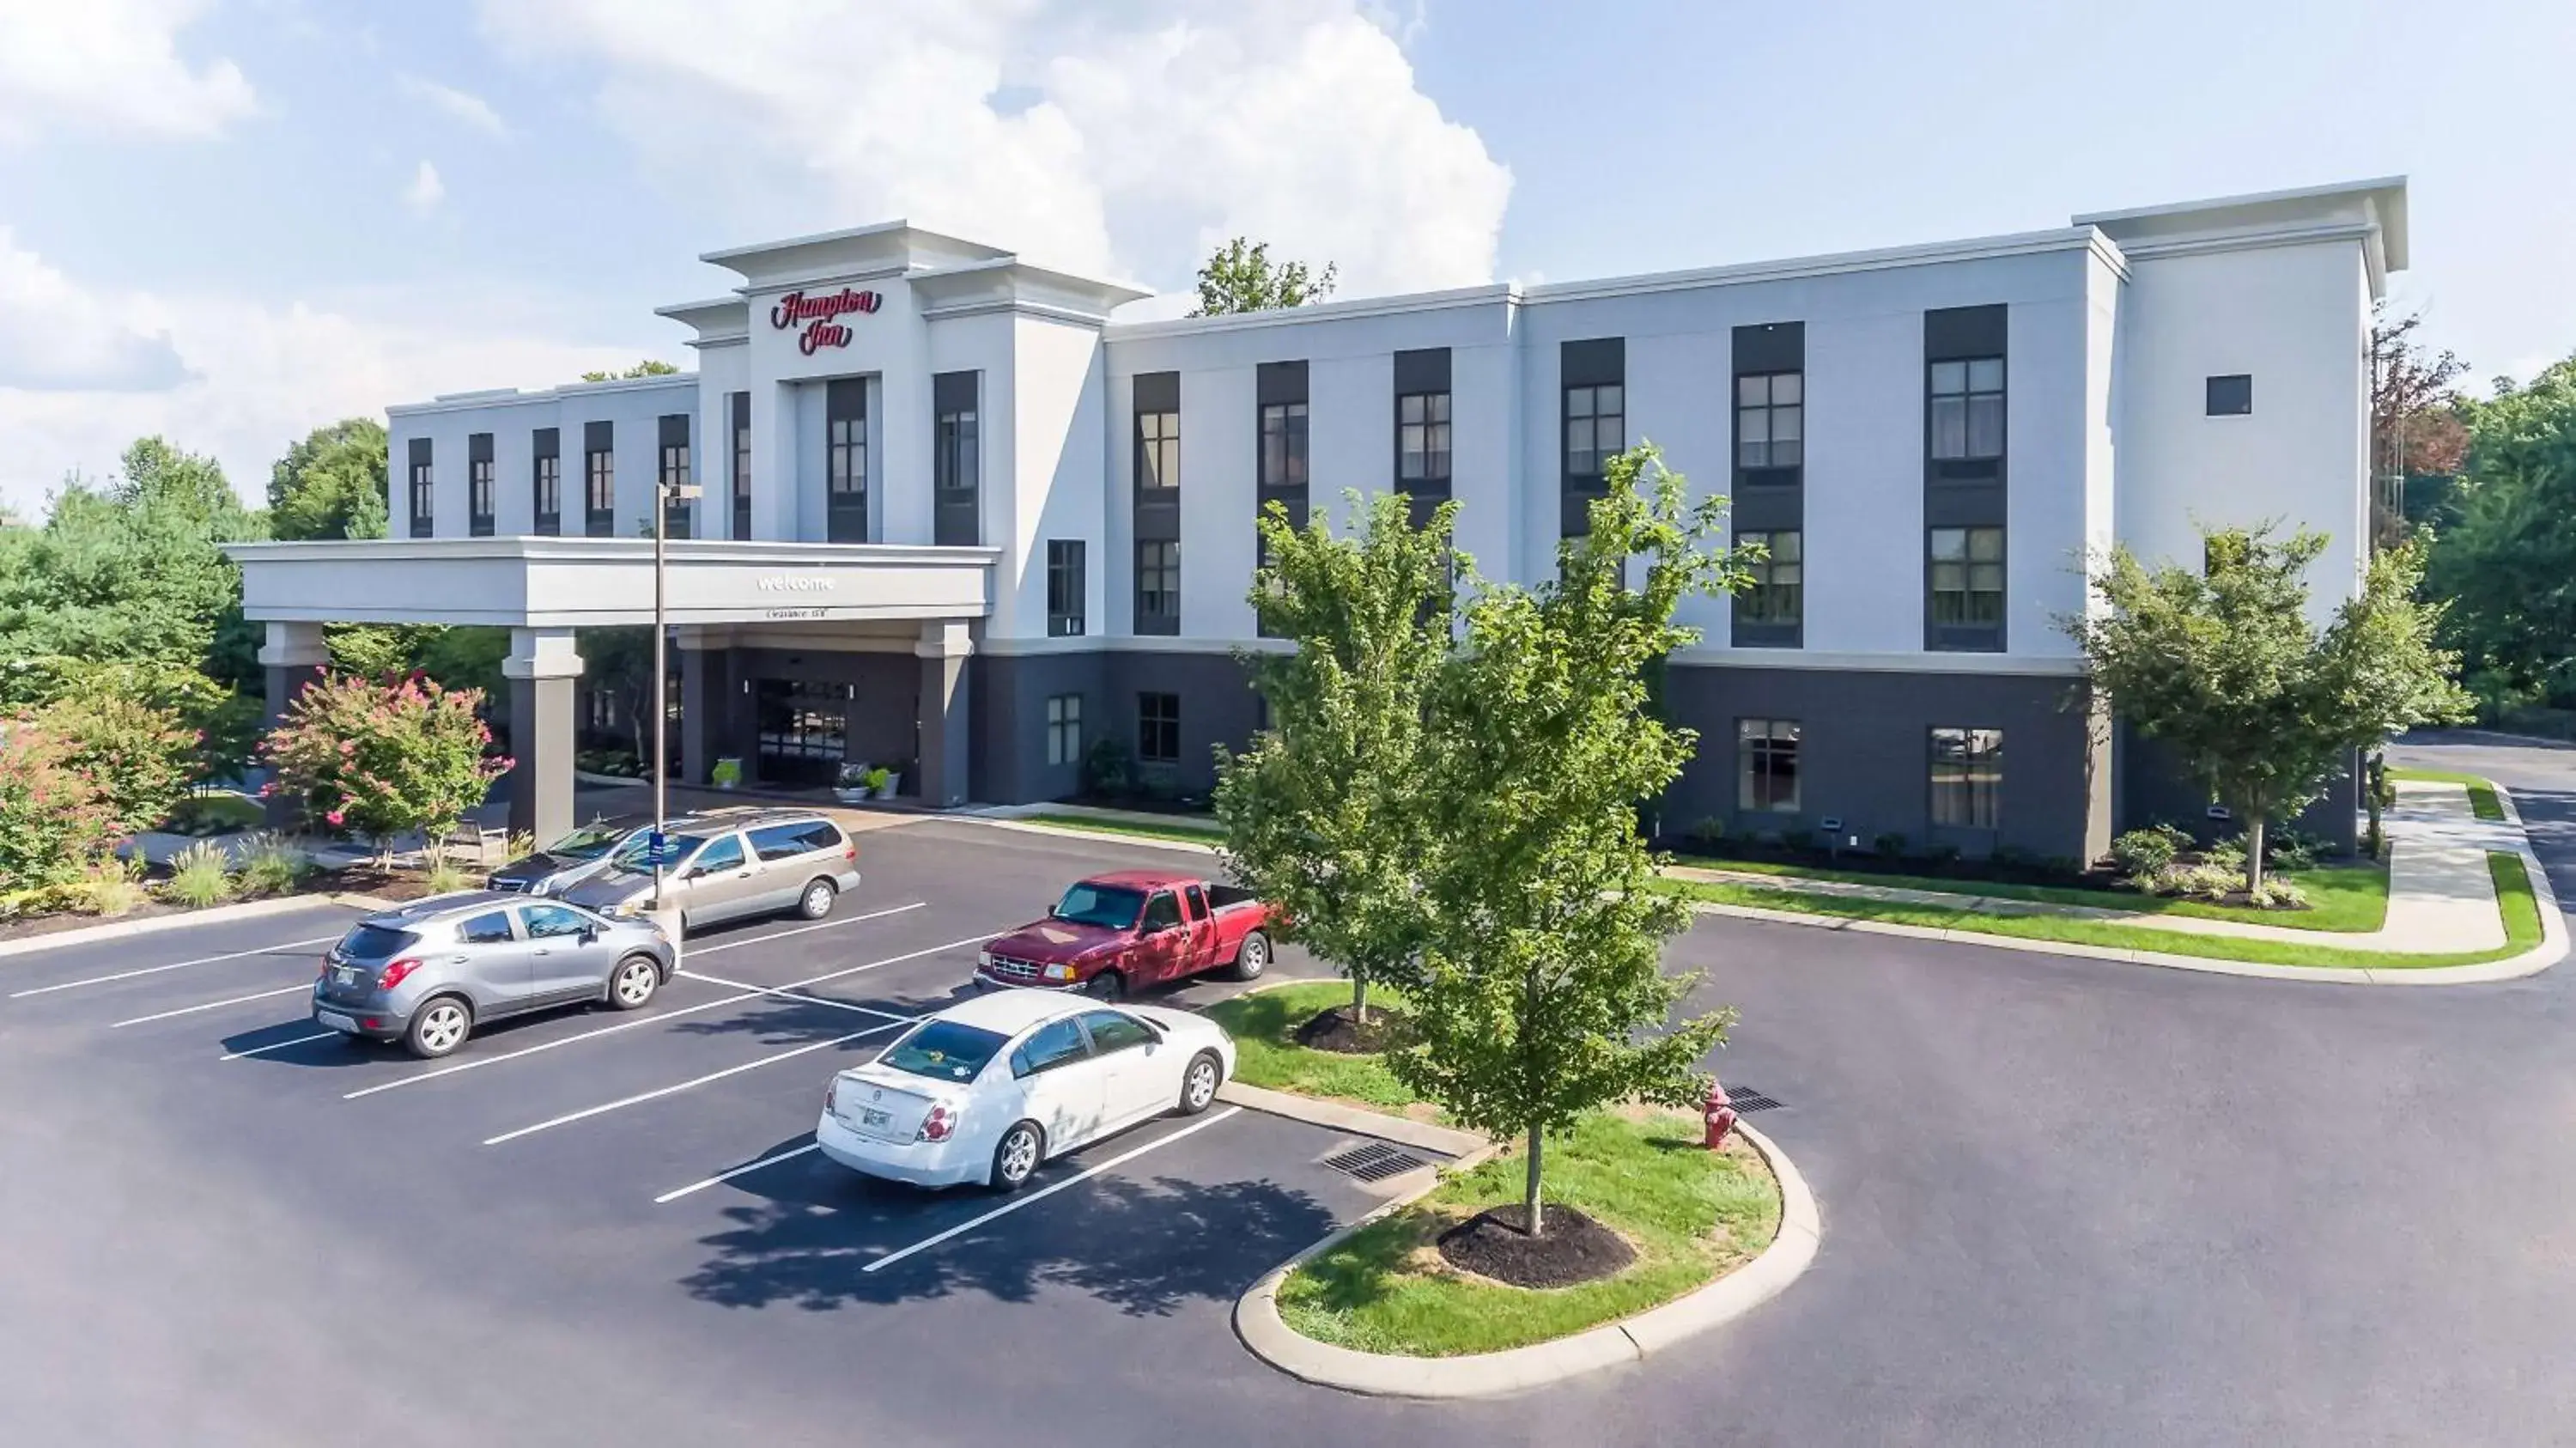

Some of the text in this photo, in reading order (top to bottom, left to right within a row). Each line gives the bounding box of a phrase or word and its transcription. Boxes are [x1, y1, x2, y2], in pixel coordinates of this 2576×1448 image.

[771, 288, 883, 330] Hampton
[799, 319, 853, 356] Inn
[756, 573, 835, 592] welcome
